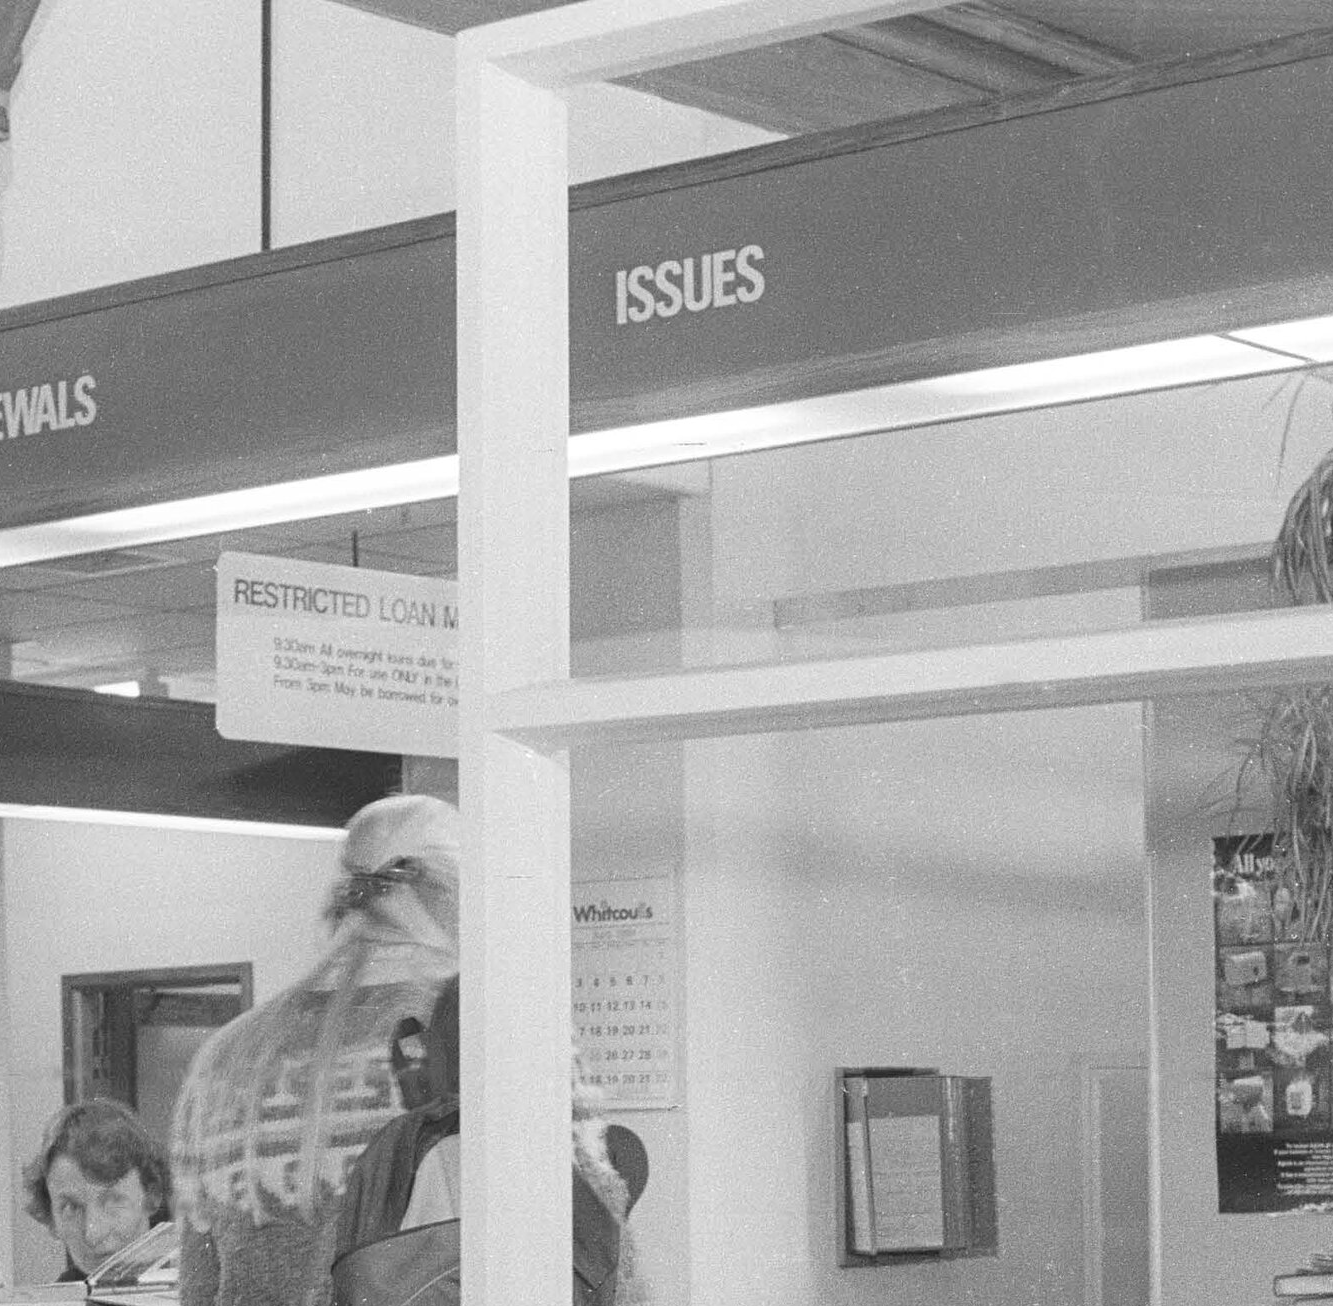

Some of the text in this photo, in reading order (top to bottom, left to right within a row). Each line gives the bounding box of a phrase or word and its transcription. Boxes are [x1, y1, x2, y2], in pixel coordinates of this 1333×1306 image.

[616, 244, 766, 325] ISSUES
[234, 578, 371, 619] RESTRICTED
[379, 597, 436, 628] LOAN
[337, 647, 383, 664] overnight
[273, 674, 302, 690] From
[334, 681, 356, 698] May
[360, 683, 373, 698] be
[377, 686, 427, 704] borrowed
[392, 668, 419, 684] ONLY
